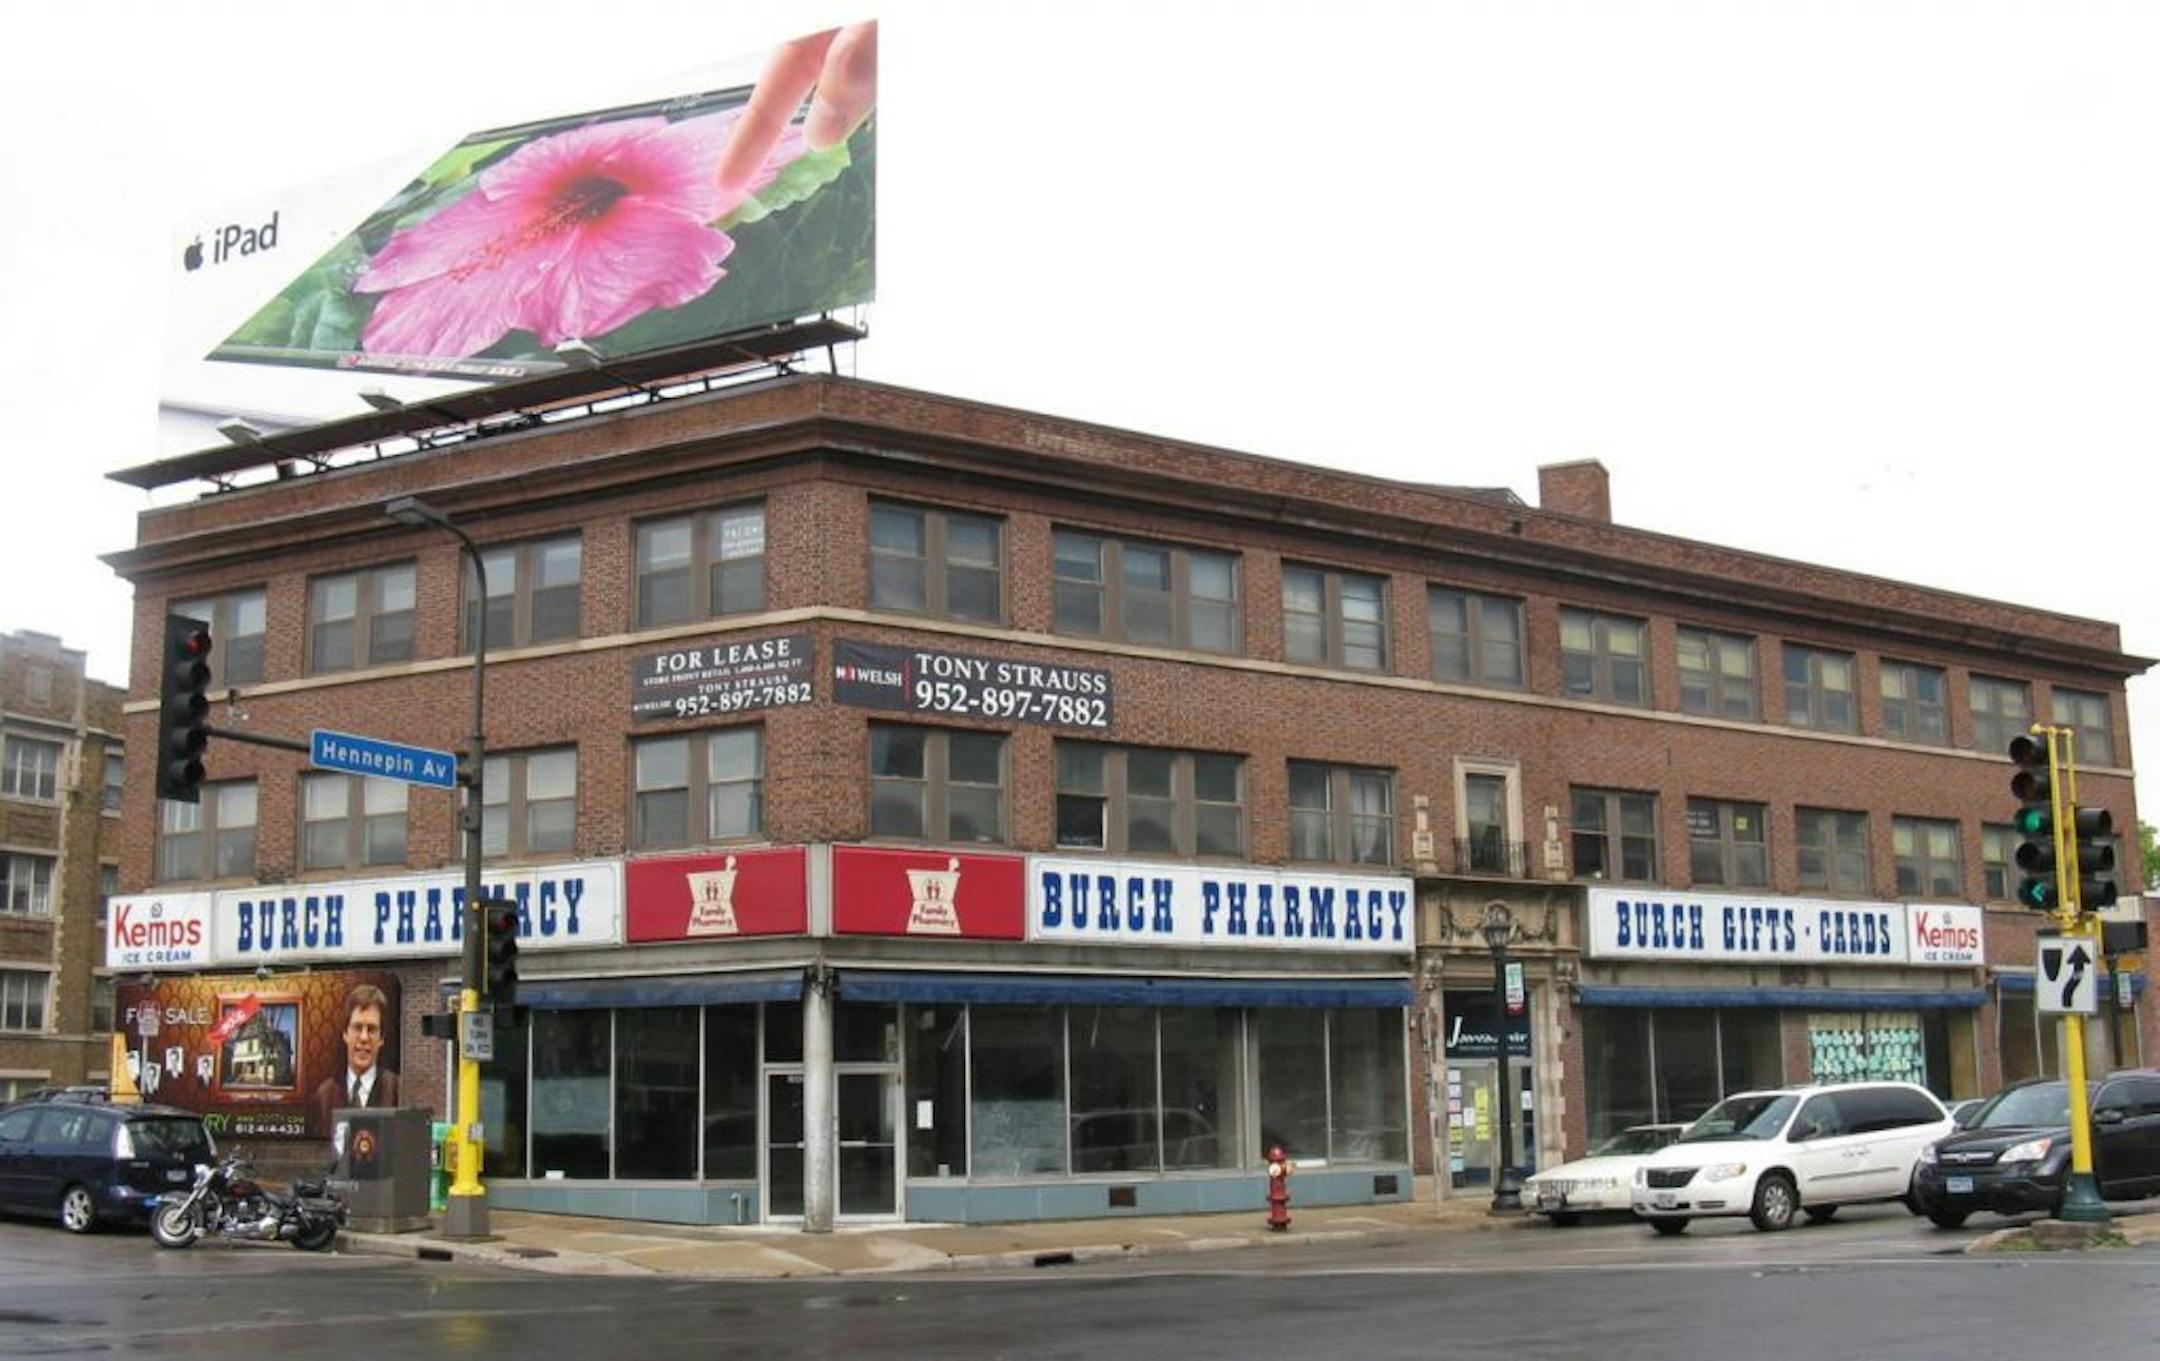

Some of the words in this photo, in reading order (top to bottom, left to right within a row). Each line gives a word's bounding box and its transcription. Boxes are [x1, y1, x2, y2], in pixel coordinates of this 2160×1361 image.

[214, 210, 279, 264] iPad
[655, 651, 703, 674] FOR
[713, 638, 791, 667] LEASE
[915, 653, 989, 682] TONY
[997, 664, 1107, 694] STRAUSS
[698, 679, 731, 694] TONY
[734, 673, 789, 690] STRAUSS
[857, 668, 903, 687] WELSH
[675, 682, 812, 718] 952-897-7882
[916, 680, 1108, 727] 952-897-7882
[322, 739, 414, 775] Hennepin
[422, 758, 447, 778] Av
[238, 895, 344, 953] BURCH
[374, 878, 584, 945] PHARACY
[1041, 871, 1173, 934] BURCH
[1201, 881, 1406, 941] PHARMACY
[115, 903, 202, 949] Kemps
[1616, 900, 1704, 949] BURCH
[1722, 905, 1796, 952] GIFTS
[1819, 909, 1891, 955] CARDS
[1915, 911, 1978, 950] Kemps
[122, 952, 140, 963] ICE
[147, 950, 191, 963] CREAM
[1924, 951, 1937, 960] ICE
[1942, 951, 1973, 960] CREAM
